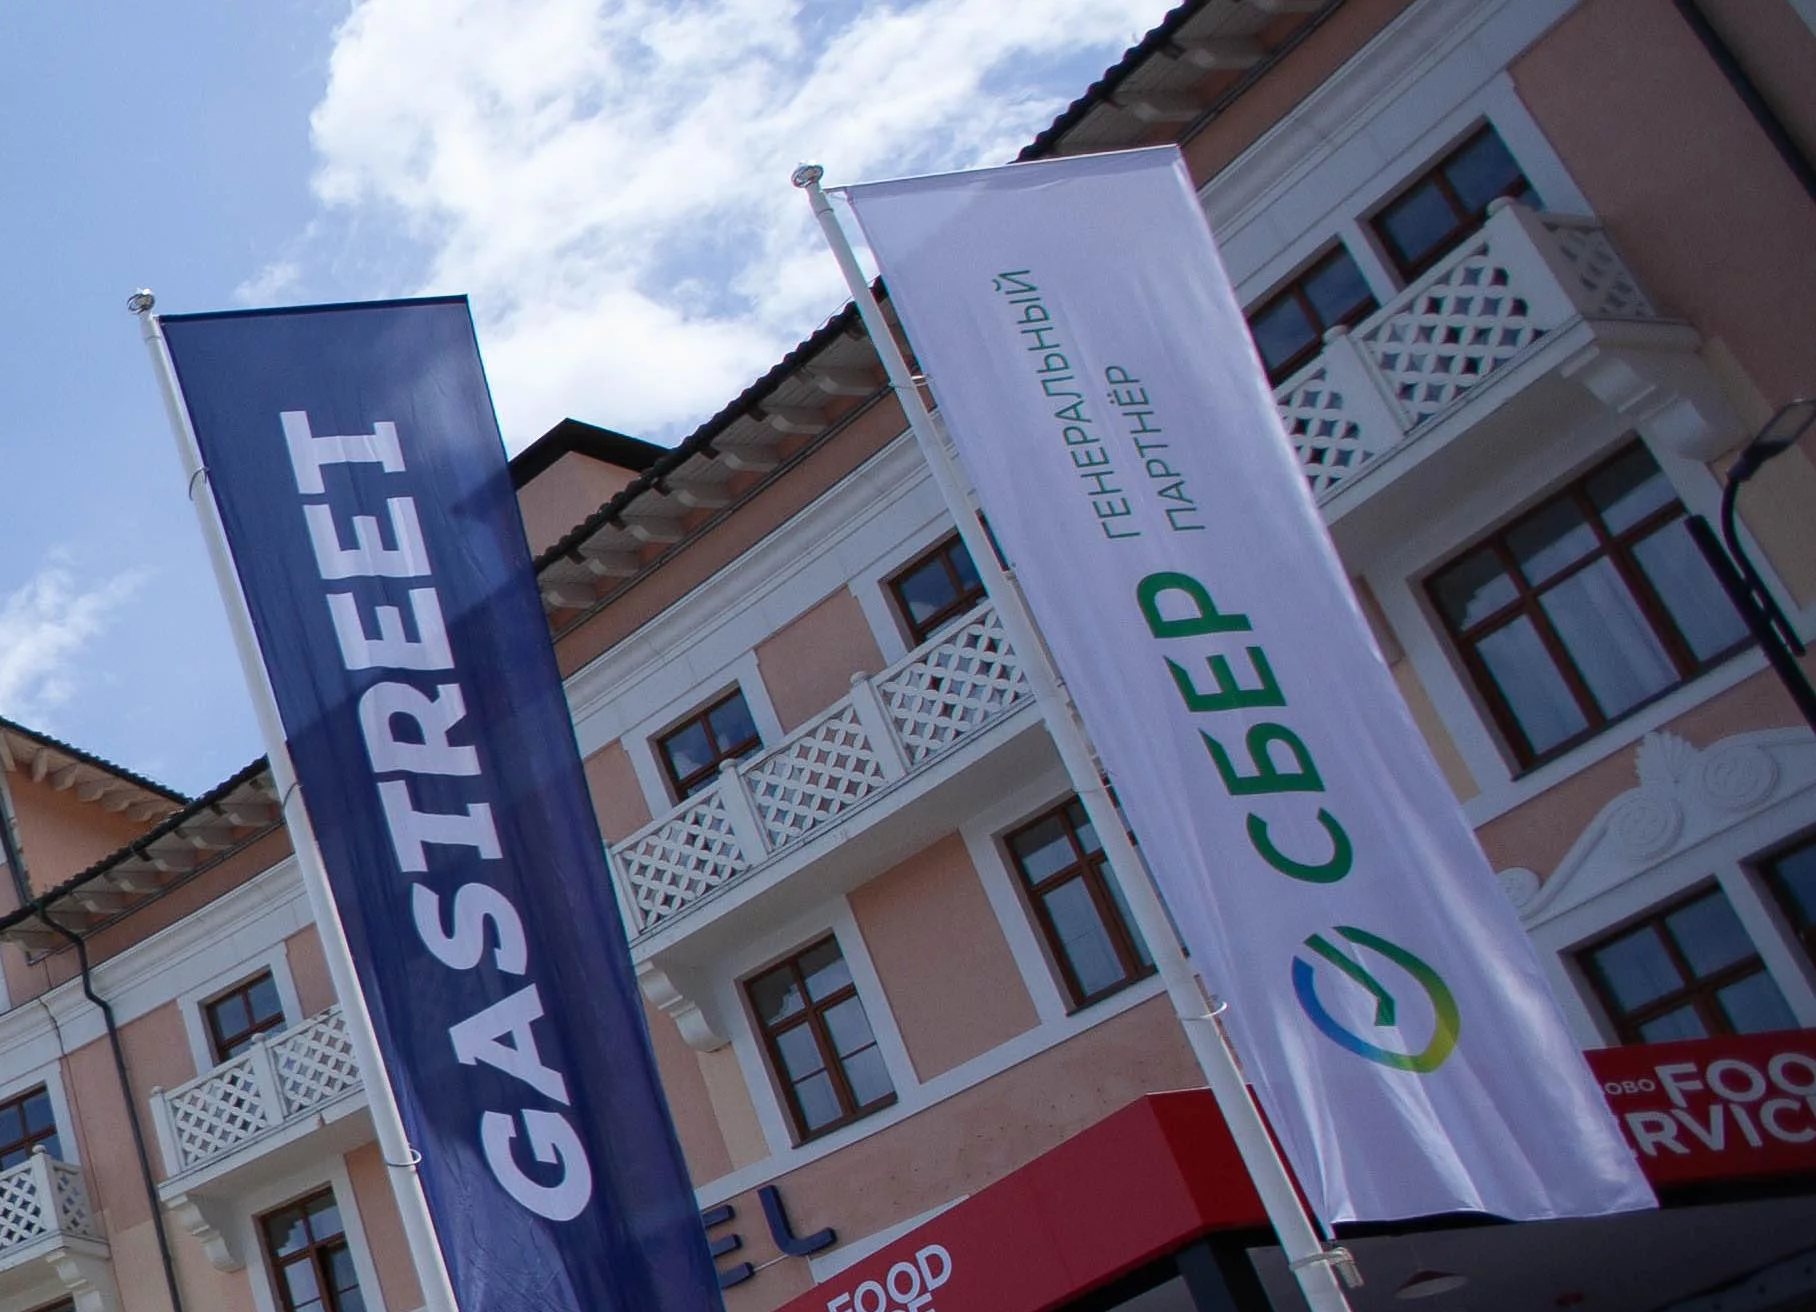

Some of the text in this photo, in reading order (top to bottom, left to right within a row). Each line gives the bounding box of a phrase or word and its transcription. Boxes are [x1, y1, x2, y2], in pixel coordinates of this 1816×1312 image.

[992, 269, 1141, 541] ГЕНЕРАЛЬНЫЙ
[1106, 364, 1206, 532] ПАРТНЁР
[280, 410, 594, 1222] GASTREET
[1136, 570, 1354, 884] СБЕР
